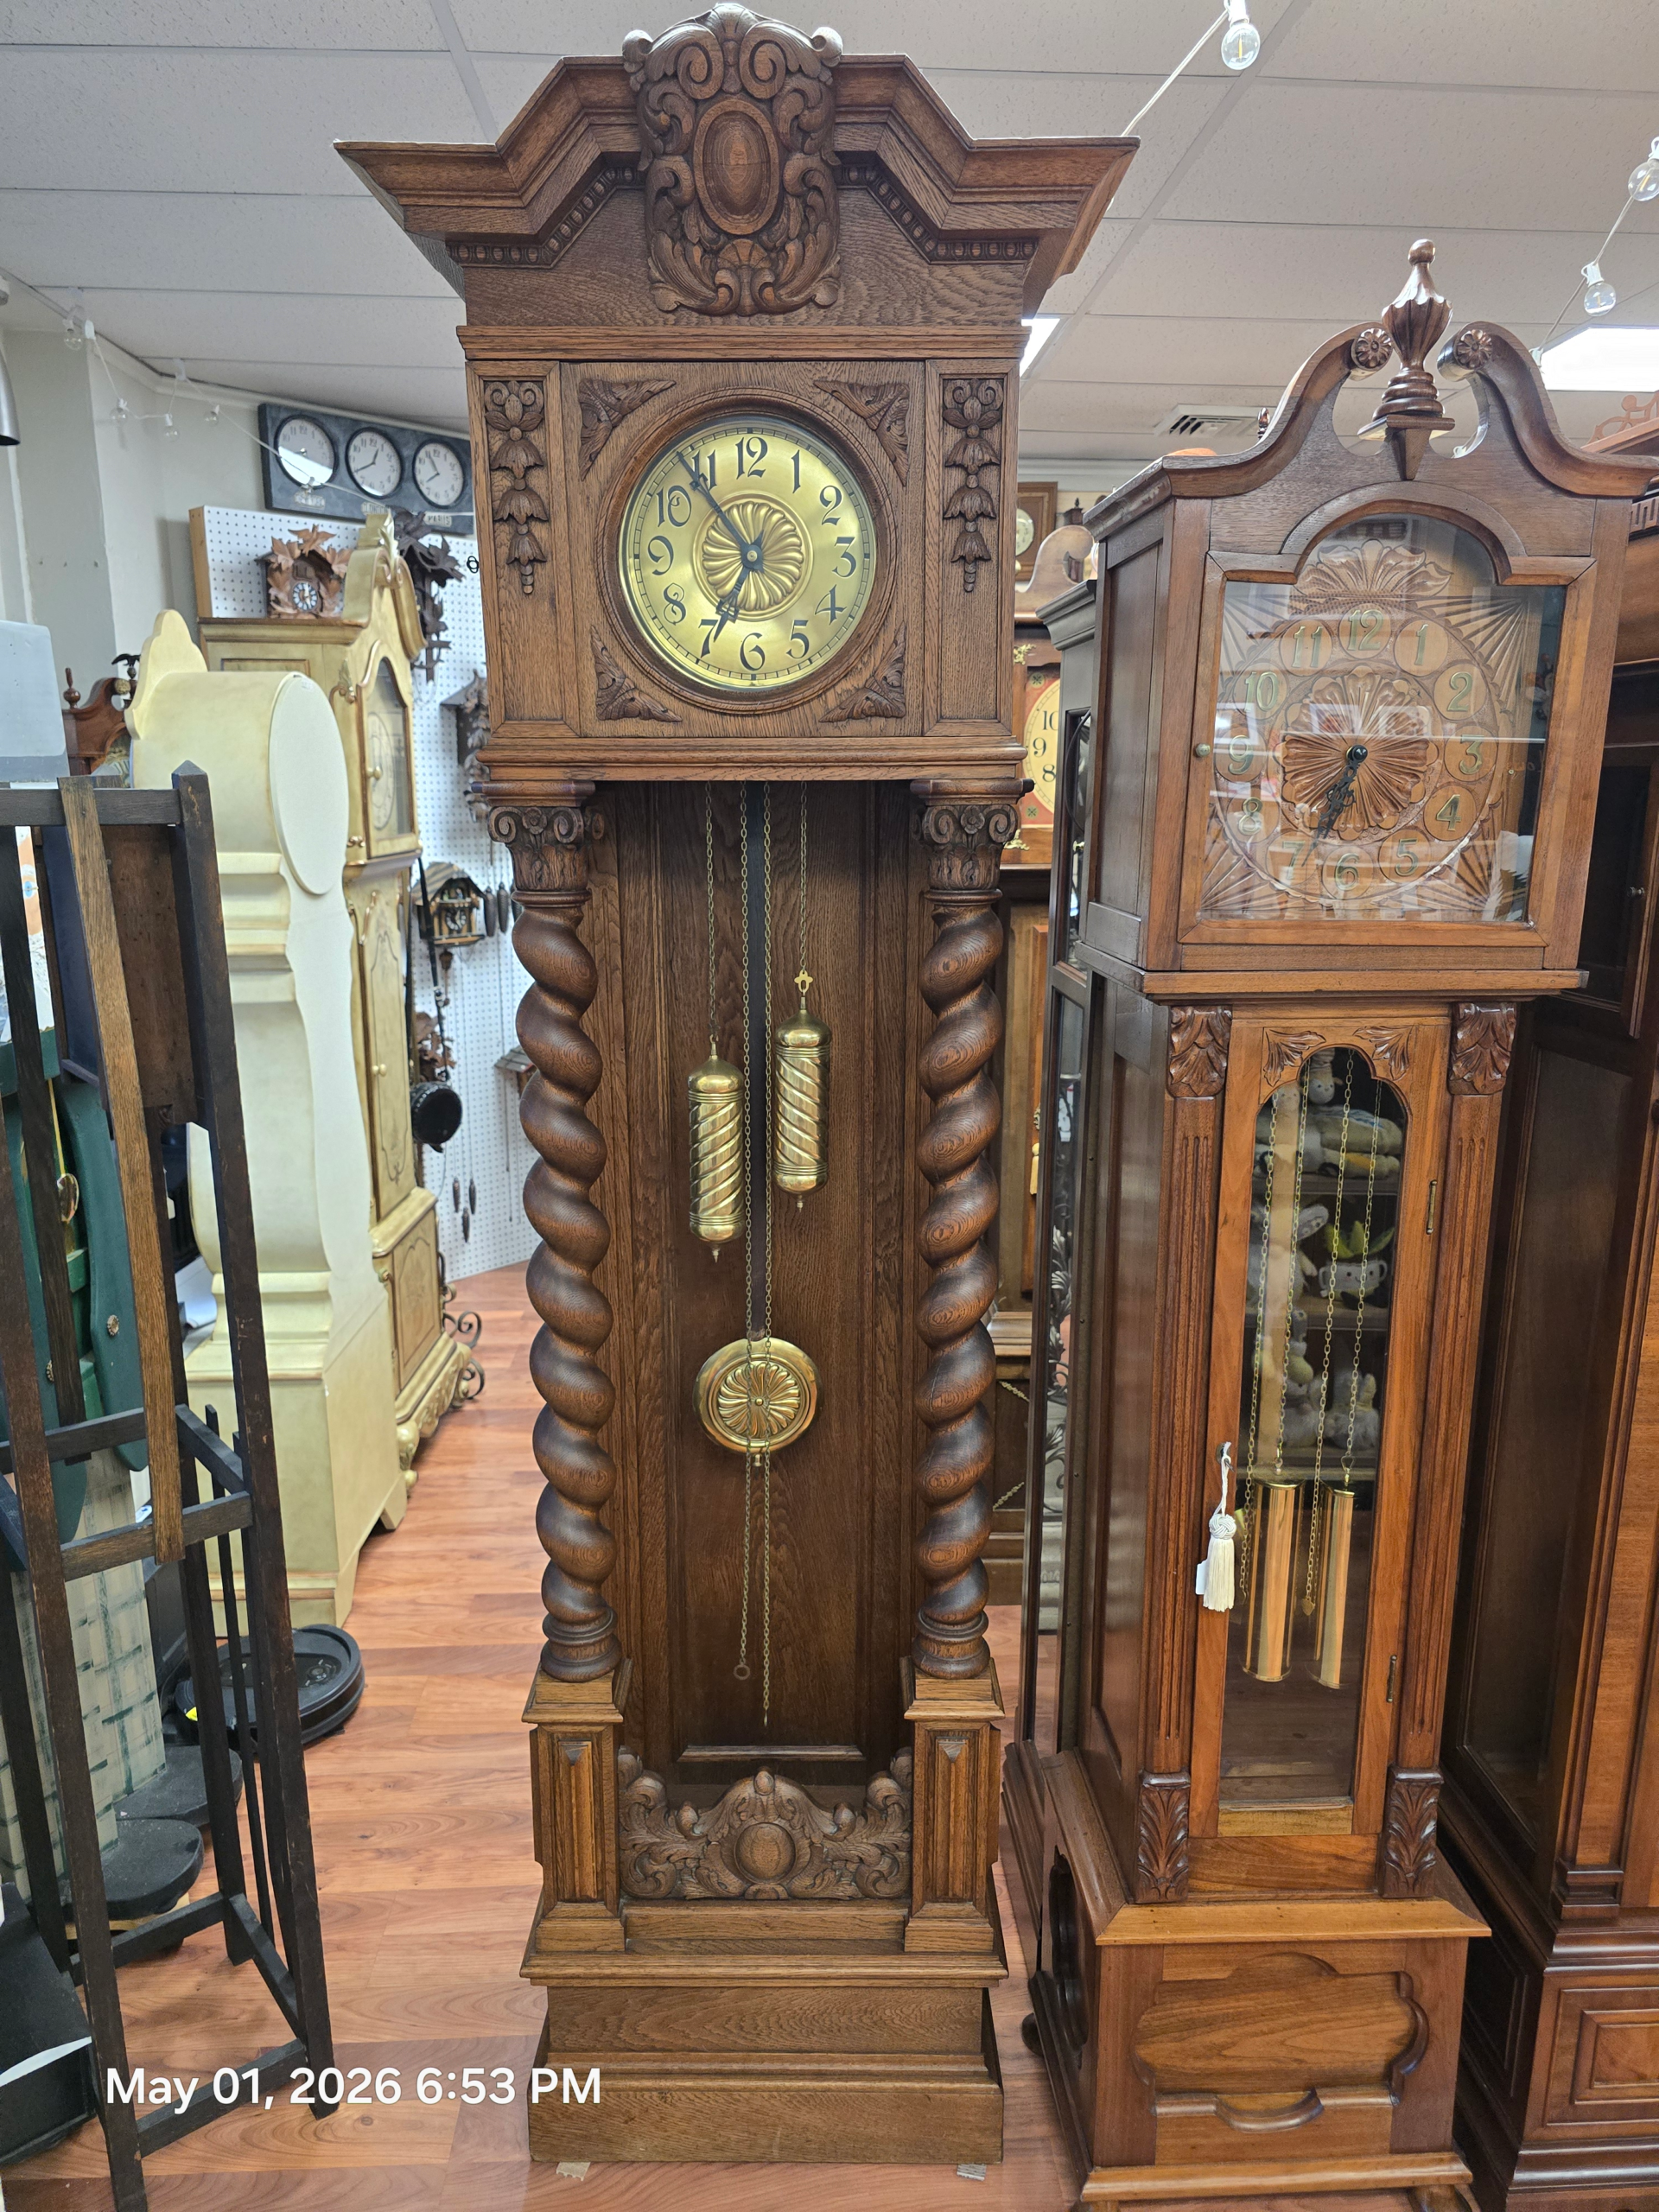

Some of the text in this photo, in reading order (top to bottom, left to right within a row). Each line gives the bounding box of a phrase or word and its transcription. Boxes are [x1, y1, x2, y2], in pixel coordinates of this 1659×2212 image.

[692, 449, 716, 491] 11
[735, 436, 768, 480] 12
[791, 449, 801, 493] 1
[656, 485, 692, 527] 10
[819, 486, 842, 525] 2
[647, 536, 674, 575] 9
[832, 537, 856, 578] 3
[664, 582, 686, 625] 8
[815, 584, 848, 625] 4
[698, 619, 719, 658] 7
[786, 620, 810, 658] 5
[1292, 626, 1323, 668] 11
[1347, 609, 1383, 652] 12
[1415, 624, 1429, 666] 1
[740, 632, 766, 671] 6
[1245, 671, 1279, 712] 10
[1447, 671, 1473, 712] 2
[1033, 737, 1046, 758] 9
[1228, 735, 1254, 775] 9
[1459, 734, 1484, 775] 3
[1042, 764, 1056, 782] 8
[1237, 797, 1263, 836] 8
[1436, 794, 1461, 831] 4
[1281, 841, 1306, 880] 7
[1334, 853, 1360, 891] 6
[1394, 838, 1419, 877] 5
